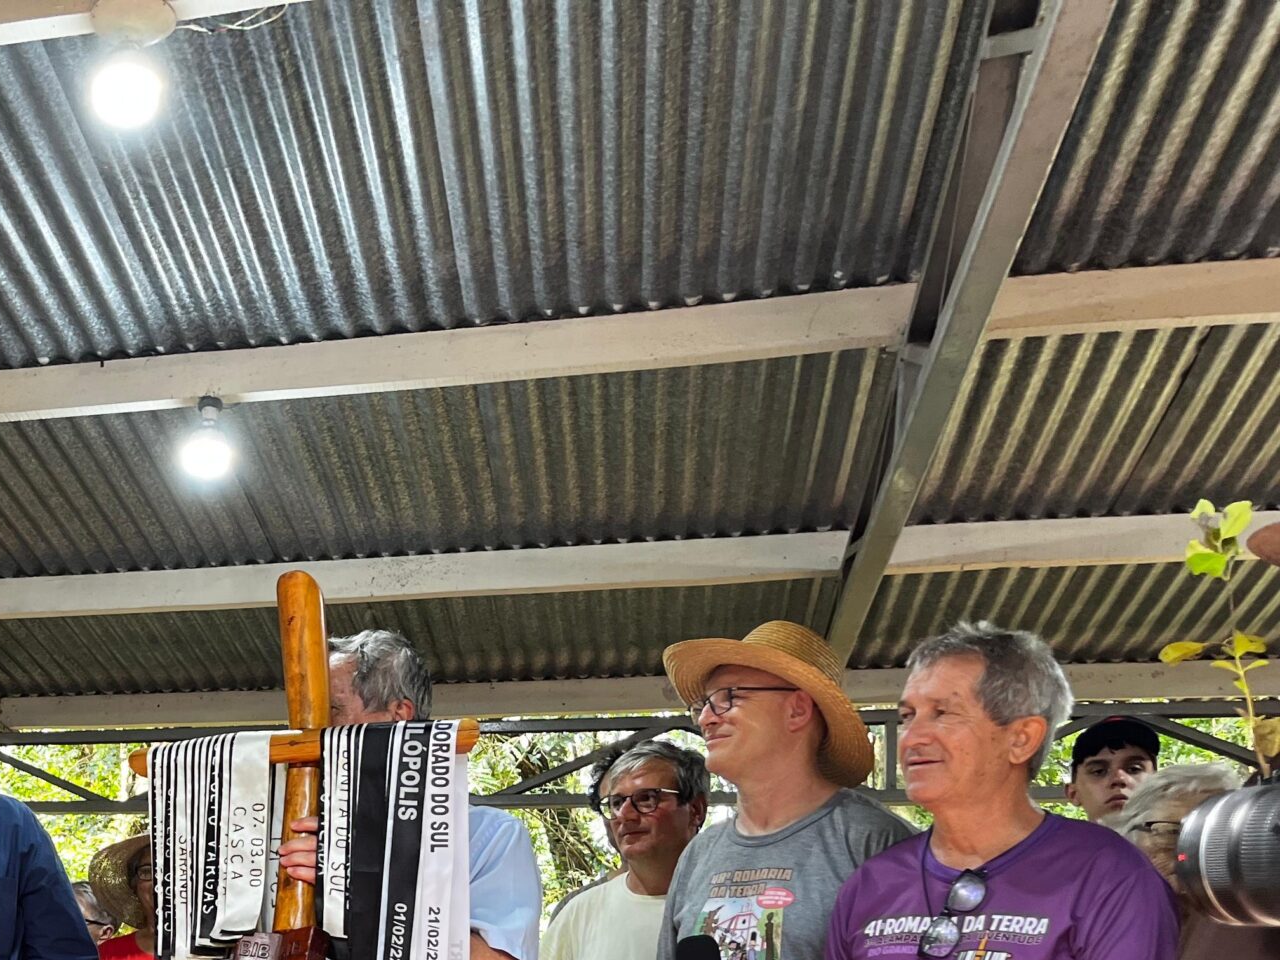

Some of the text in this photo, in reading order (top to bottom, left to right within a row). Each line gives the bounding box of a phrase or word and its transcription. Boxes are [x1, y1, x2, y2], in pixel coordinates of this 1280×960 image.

[397, 723, 427, 821] ILÓPOLIS
[430, 719, 453, 853] DORADO DO SUL
[230, 806, 247, 881] CASCA
[328, 860, 348, 896] SUL
[962, 915, 986, 933] DA
[990, 915, 1049, 935] TERRA
